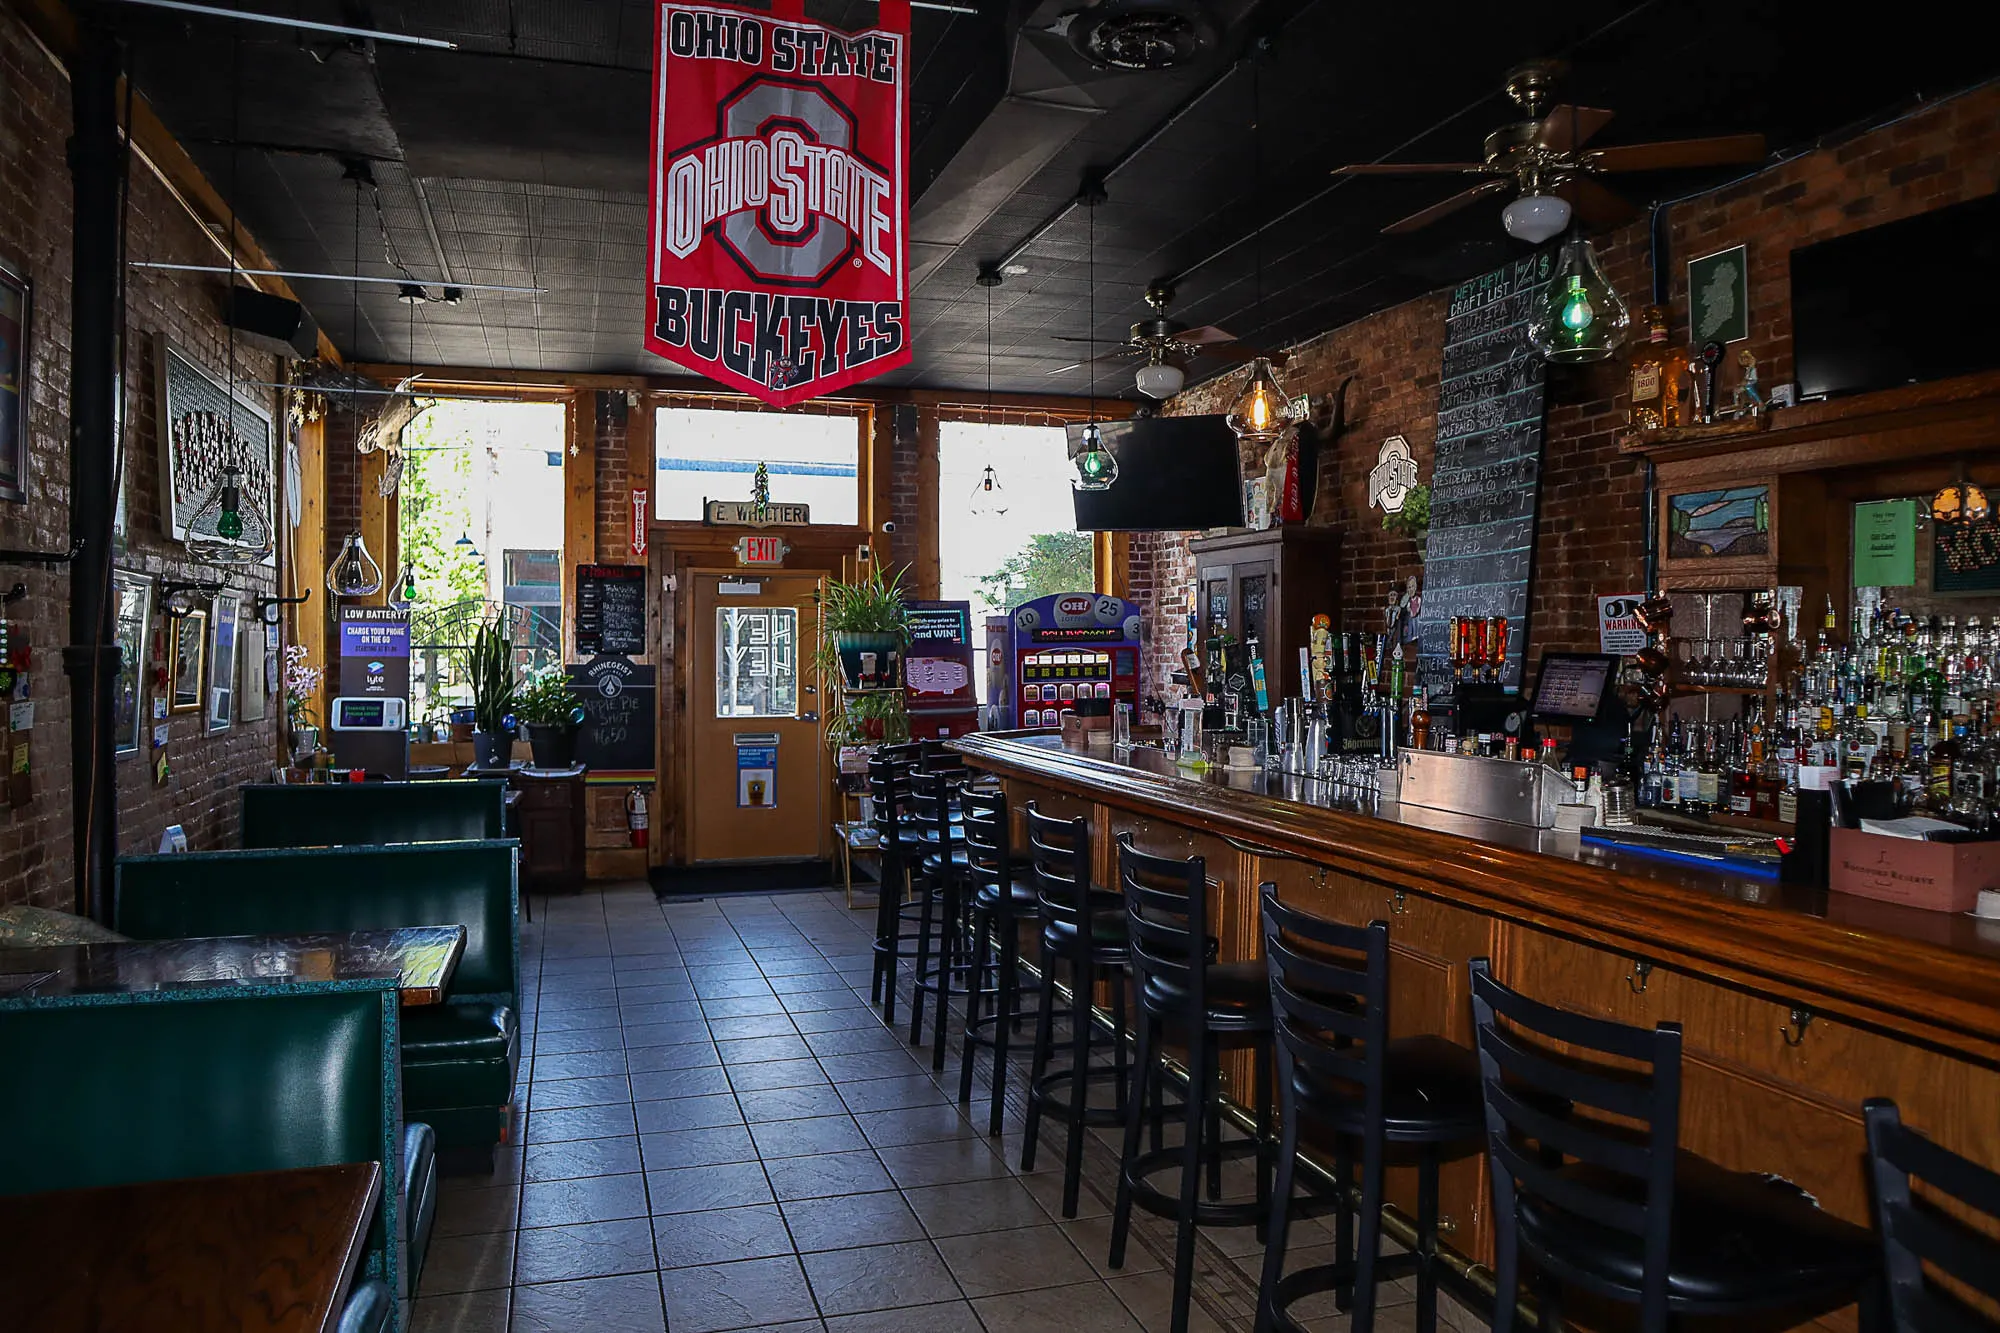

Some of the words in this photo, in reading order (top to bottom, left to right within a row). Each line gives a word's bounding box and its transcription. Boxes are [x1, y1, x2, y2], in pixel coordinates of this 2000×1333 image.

[669, 12, 763, 66] OHIO
[771, 27, 895, 84] STATE
[1538, 255, 1550, 279] $
[1455, 282, 1476, 302] HEY
[1479, 268, 1505, 291] HEY!
[1451, 292, 1483, 317] DRAFT
[1487, 281, 1511, 302] LIST
[1484, 302, 1508, 321] IPA
[654, 285, 902, 390] BUCKEYES
[1637, 376, 1655, 389] 1800
[633, 493, 646, 501] FIRE
[716, 505, 729, 521] E.
[747, 537, 777, 561] EXIT
[1061, 600, 1088, 611] OH!
[1099, 600, 1119, 617] 25
[345, 609, 364, 619] LOW
[366, 609, 407, 620] BATTERY?
[1018, 612, 1034, 627] 10
[347, 627, 370, 636] CHARGE
[370, 627, 385, 636] YOUR
[386, 627, 405, 636] PHONE
[1605, 619, 1641, 630] WARNING
[361, 636, 370, 644] ON
[370, 636, 381, 644] THE
[382, 636, 391, 644] GO
[913, 629, 932, 639] and
[933, 629, 956, 638] WIN!
[587, 661, 633, 677] RHINEGEIST
[366, 675, 385, 685] lyte
[621, 696, 640, 710] PIE
